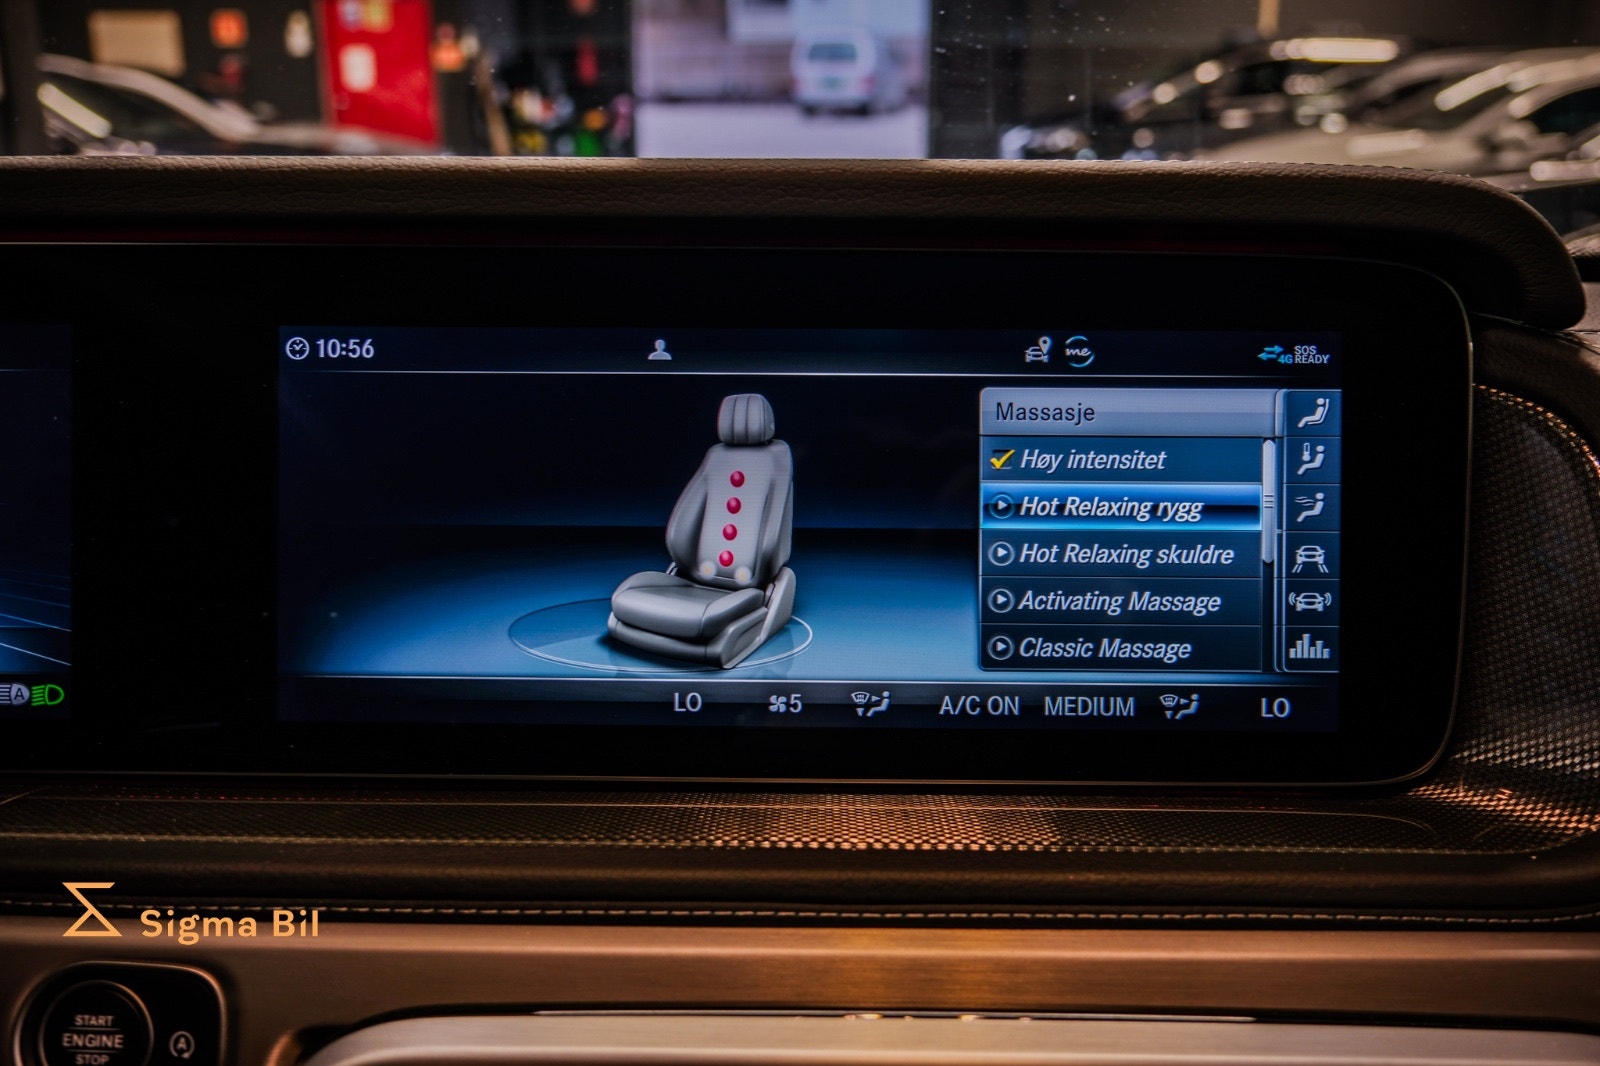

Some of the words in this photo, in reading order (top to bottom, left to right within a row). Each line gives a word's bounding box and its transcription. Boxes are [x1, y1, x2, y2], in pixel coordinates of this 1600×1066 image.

[316, 338, 375, 358] 10:56
[1294, 345, 1317, 355] SOS
[1278, 354, 1293, 364] 4G
[1294, 354, 1330, 364] READY
[996, 402, 1095, 425] Massasje
[1020, 449, 1063, 473] Høy
[1066, 449, 1167, 470] intensitet
[1020, 496, 1057, 516] Hot
[1063, 496, 1152, 521] Relaxing
[1156, 501, 1204, 522] rygg
[1019, 543, 1058, 564] Hot
[1063, 543, 1152, 568] Relaxing
[1156, 544, 1234, 565] skuldre
[1017, 590, 1124, 615] Activating
[1128, 591, 1221, 616] Massage
[1019, 637, 1094, 658] Classic
[1098, 638, 1192, 663] Massage
[673, 692, 702, 712] LO
[789, 693, 802, 713] 5
[939, 696, 980, 715] A/C
[988, 696, 1020, 715] ON
[1044, 696, 1134, 717] MEDIUM
[1260, 698, 1291, 718] LO
[74, 1014, 114, 1026] START
[62, 1033, 124, 1048] ENGINE
[75, 1054, 109, 1066] STOP
